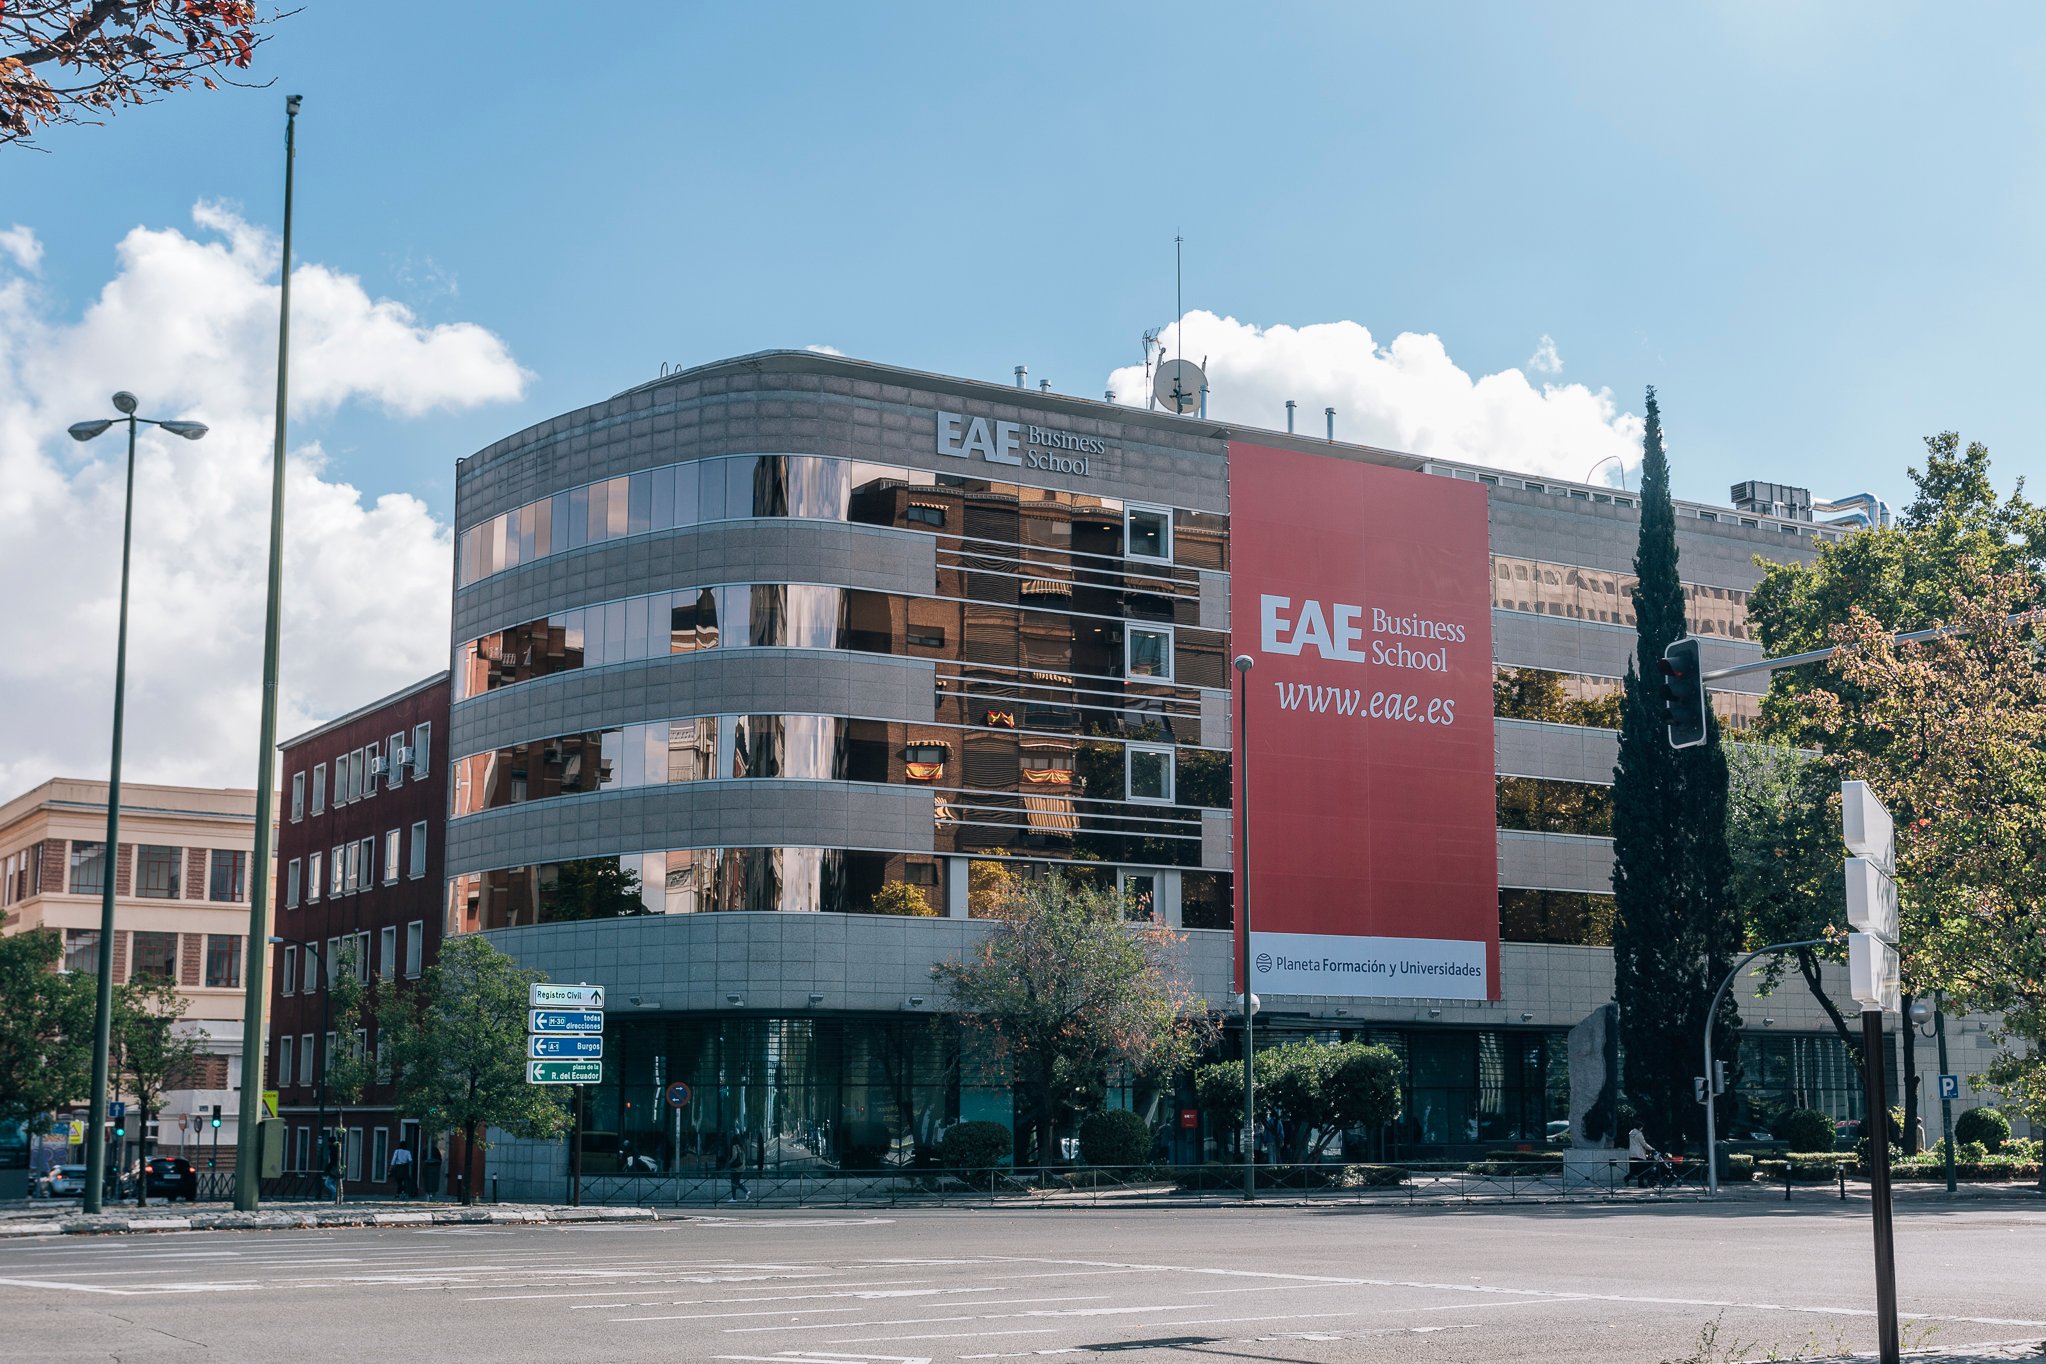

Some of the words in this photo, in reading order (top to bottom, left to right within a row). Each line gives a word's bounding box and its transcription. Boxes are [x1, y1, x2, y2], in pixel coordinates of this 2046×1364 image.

[938, 410, 1022, 466] EAE
[1027, 425, 1105, 454] Business
[1027, 449, 1090, 476] School
[1261, 593, 1366, 663] EAE
[1371, 607, 1466, 643] Business
[1372, 640, 1448, 672] School
[1274, 681, 1455, 726] www.eae.es
[1276, 956, 1320, 971] Planeta
[1323, 958, 1386, 973] Formación
[1389, 962, 1397, 977] y
[1400, 961, 1481, 977] Universidades
[537, 991, 565, 999] Registro
[567, 991, 582, 999] Civil
[577, 1042, 600, 1051] Burgos
[552, 1072, 558, 1080] R.
[560, 1072, 570, 1080] del
[572, 1072, 599, 1080] Ecuador
[1942, 1078, 1954, 1096] P
